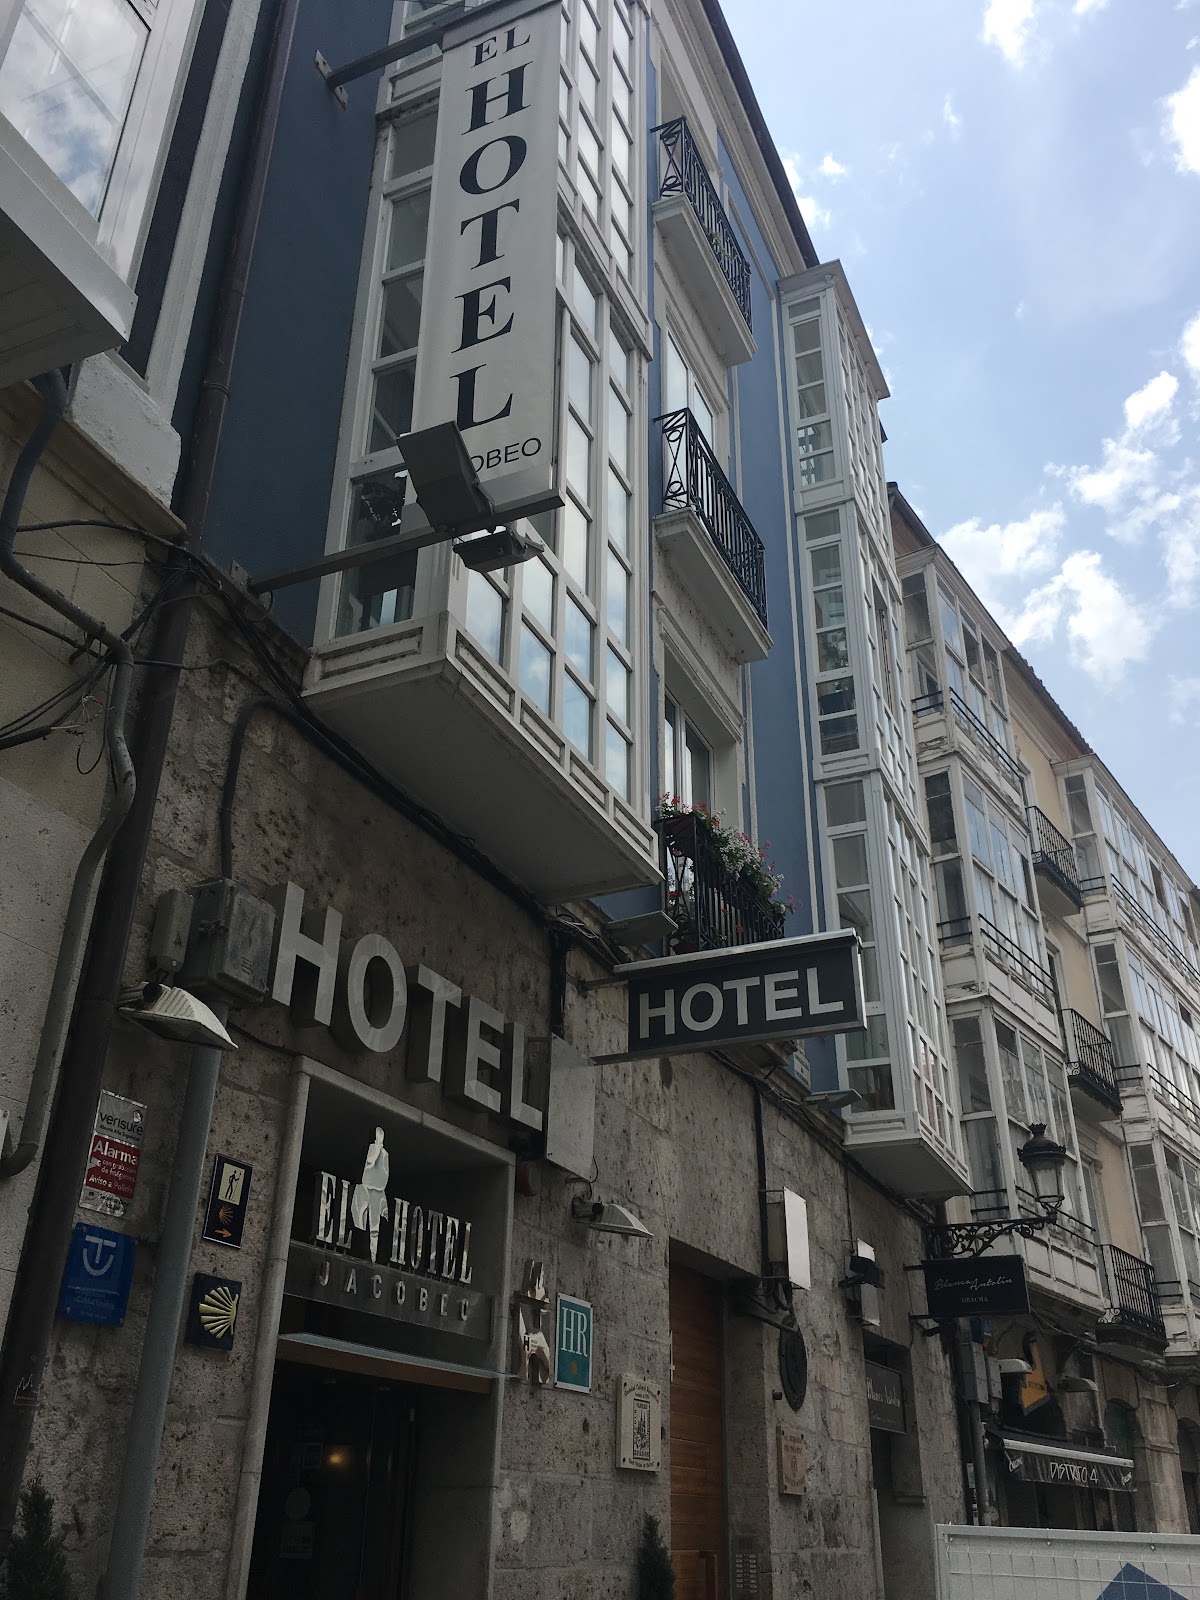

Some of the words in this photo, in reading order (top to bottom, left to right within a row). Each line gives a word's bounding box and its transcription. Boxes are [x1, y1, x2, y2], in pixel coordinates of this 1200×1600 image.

[469, 25, 531, 68] EL
[451, 60, 534, 433] HOTEL
[470, 437, 542, 473] OBEO
[271, 880, 543, 1132] HOTEL
[639, 967, 845, 1040] HOTEL
[99, 1112, 144, 1136] verisure
[93, 1139, 138, 1166] Alarma
[88, 1174, 108, 1186] Aviso
[316, 1170, 353, 1250] EL
[389, 1196, 473, 1285] HOTEL
[560, 1306, 589, 1358] HR
[1089, 1467, 1099, 1485] 4
